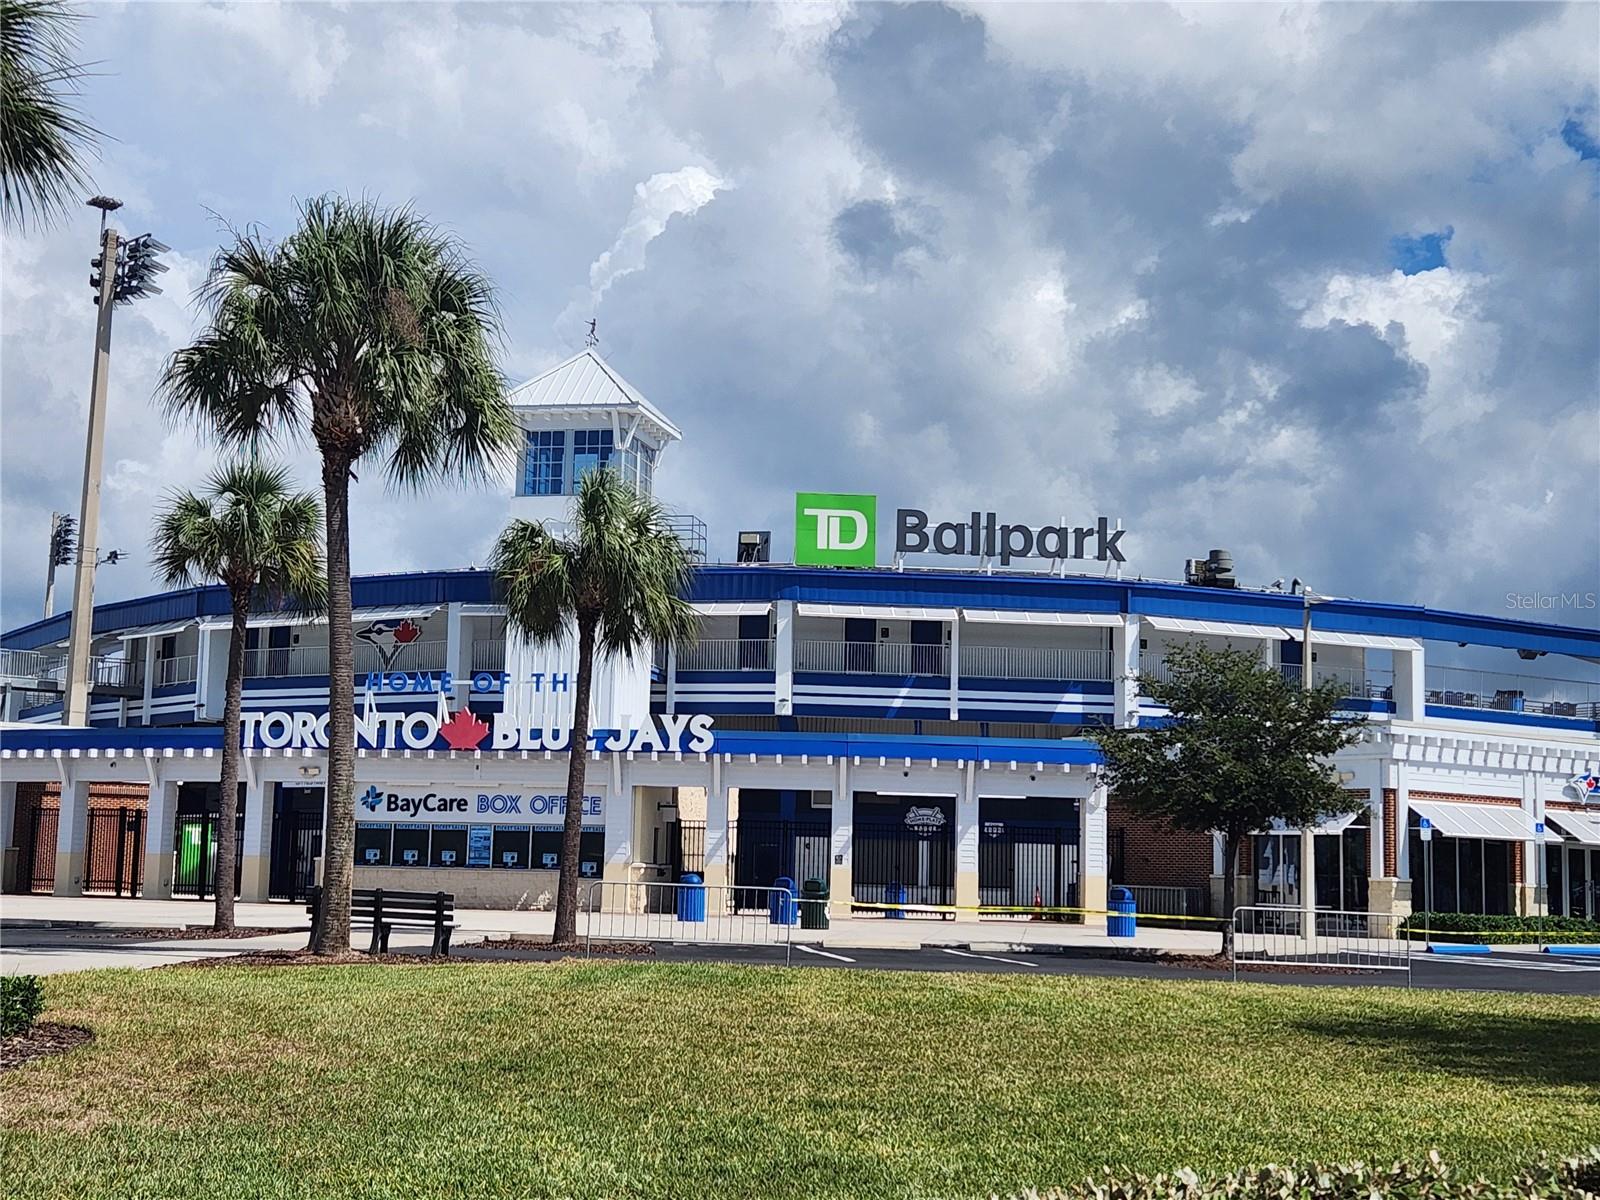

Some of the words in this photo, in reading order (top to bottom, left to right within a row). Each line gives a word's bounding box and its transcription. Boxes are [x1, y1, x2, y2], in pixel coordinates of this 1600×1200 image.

[803, 508, 868, 551] TD
[896, 508, 1127, 567] Ballpark
[367, 671, 453, 692] HOME
[473, 672, 511, 693] OF
[531, 672, 579, 693] TH
[604, 713, 715, 753] JAYS
[386, 793, 468, 817] BayCare
[477, 794, 522, 814] BOX
[530, 795, 602, 815] OFFCE
